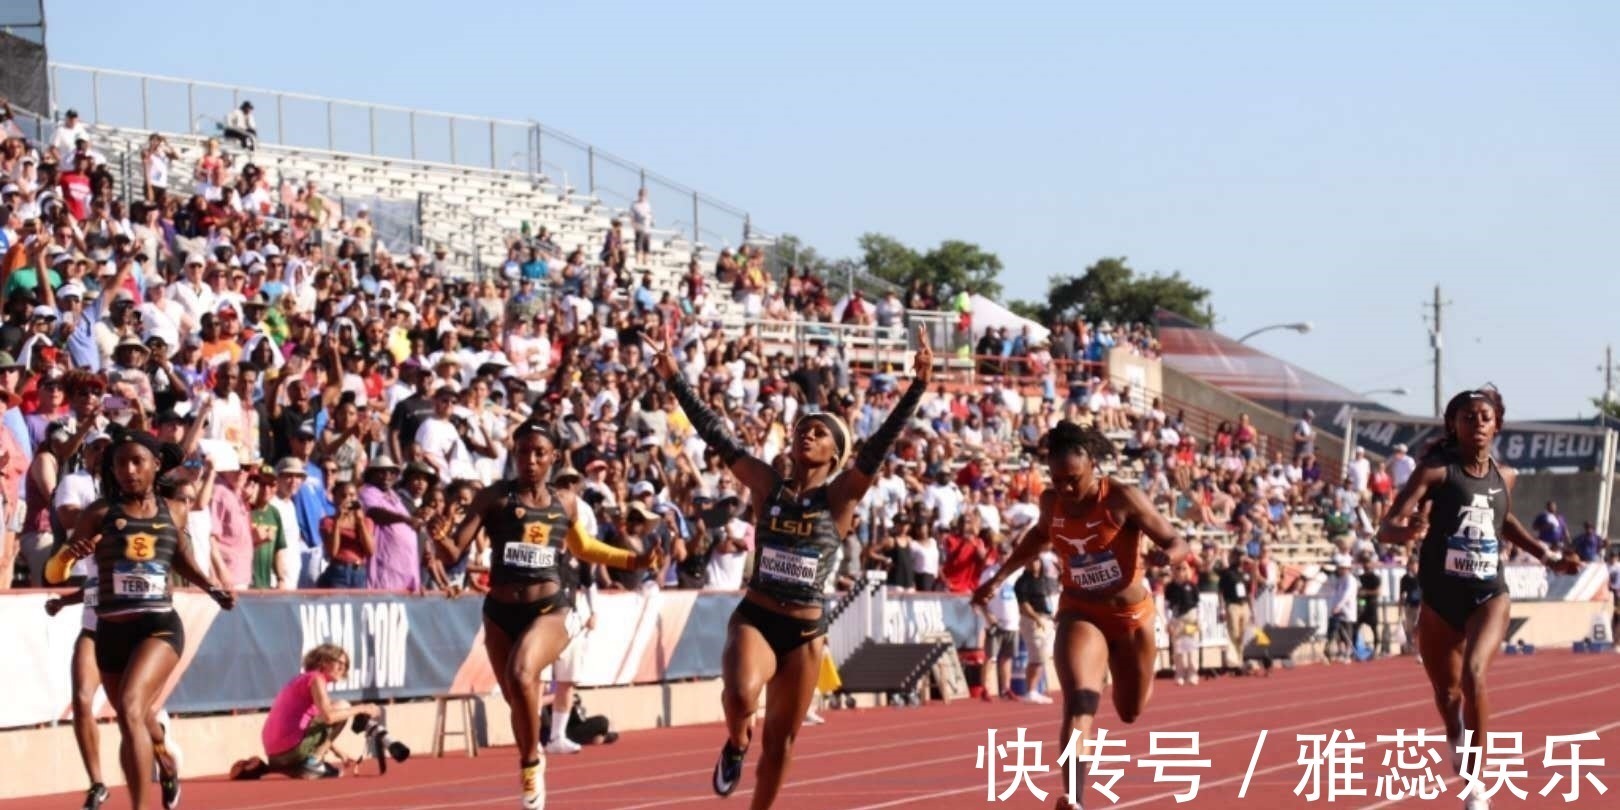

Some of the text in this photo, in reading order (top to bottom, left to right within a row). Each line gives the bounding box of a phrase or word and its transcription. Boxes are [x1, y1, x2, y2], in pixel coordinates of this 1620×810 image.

[1333, 403, 1397, 445] NAA
[1530, 432, 1595, 458] FIELD
[770, 517, 814, 537] LSU
[505, 547, 553, 566] ANNELUS
[1454, 557, 1490, 573] WHITE
[760, 556, 816, 579] RICHARDSON
[1073, 565, 1120, 586] DANIELS
